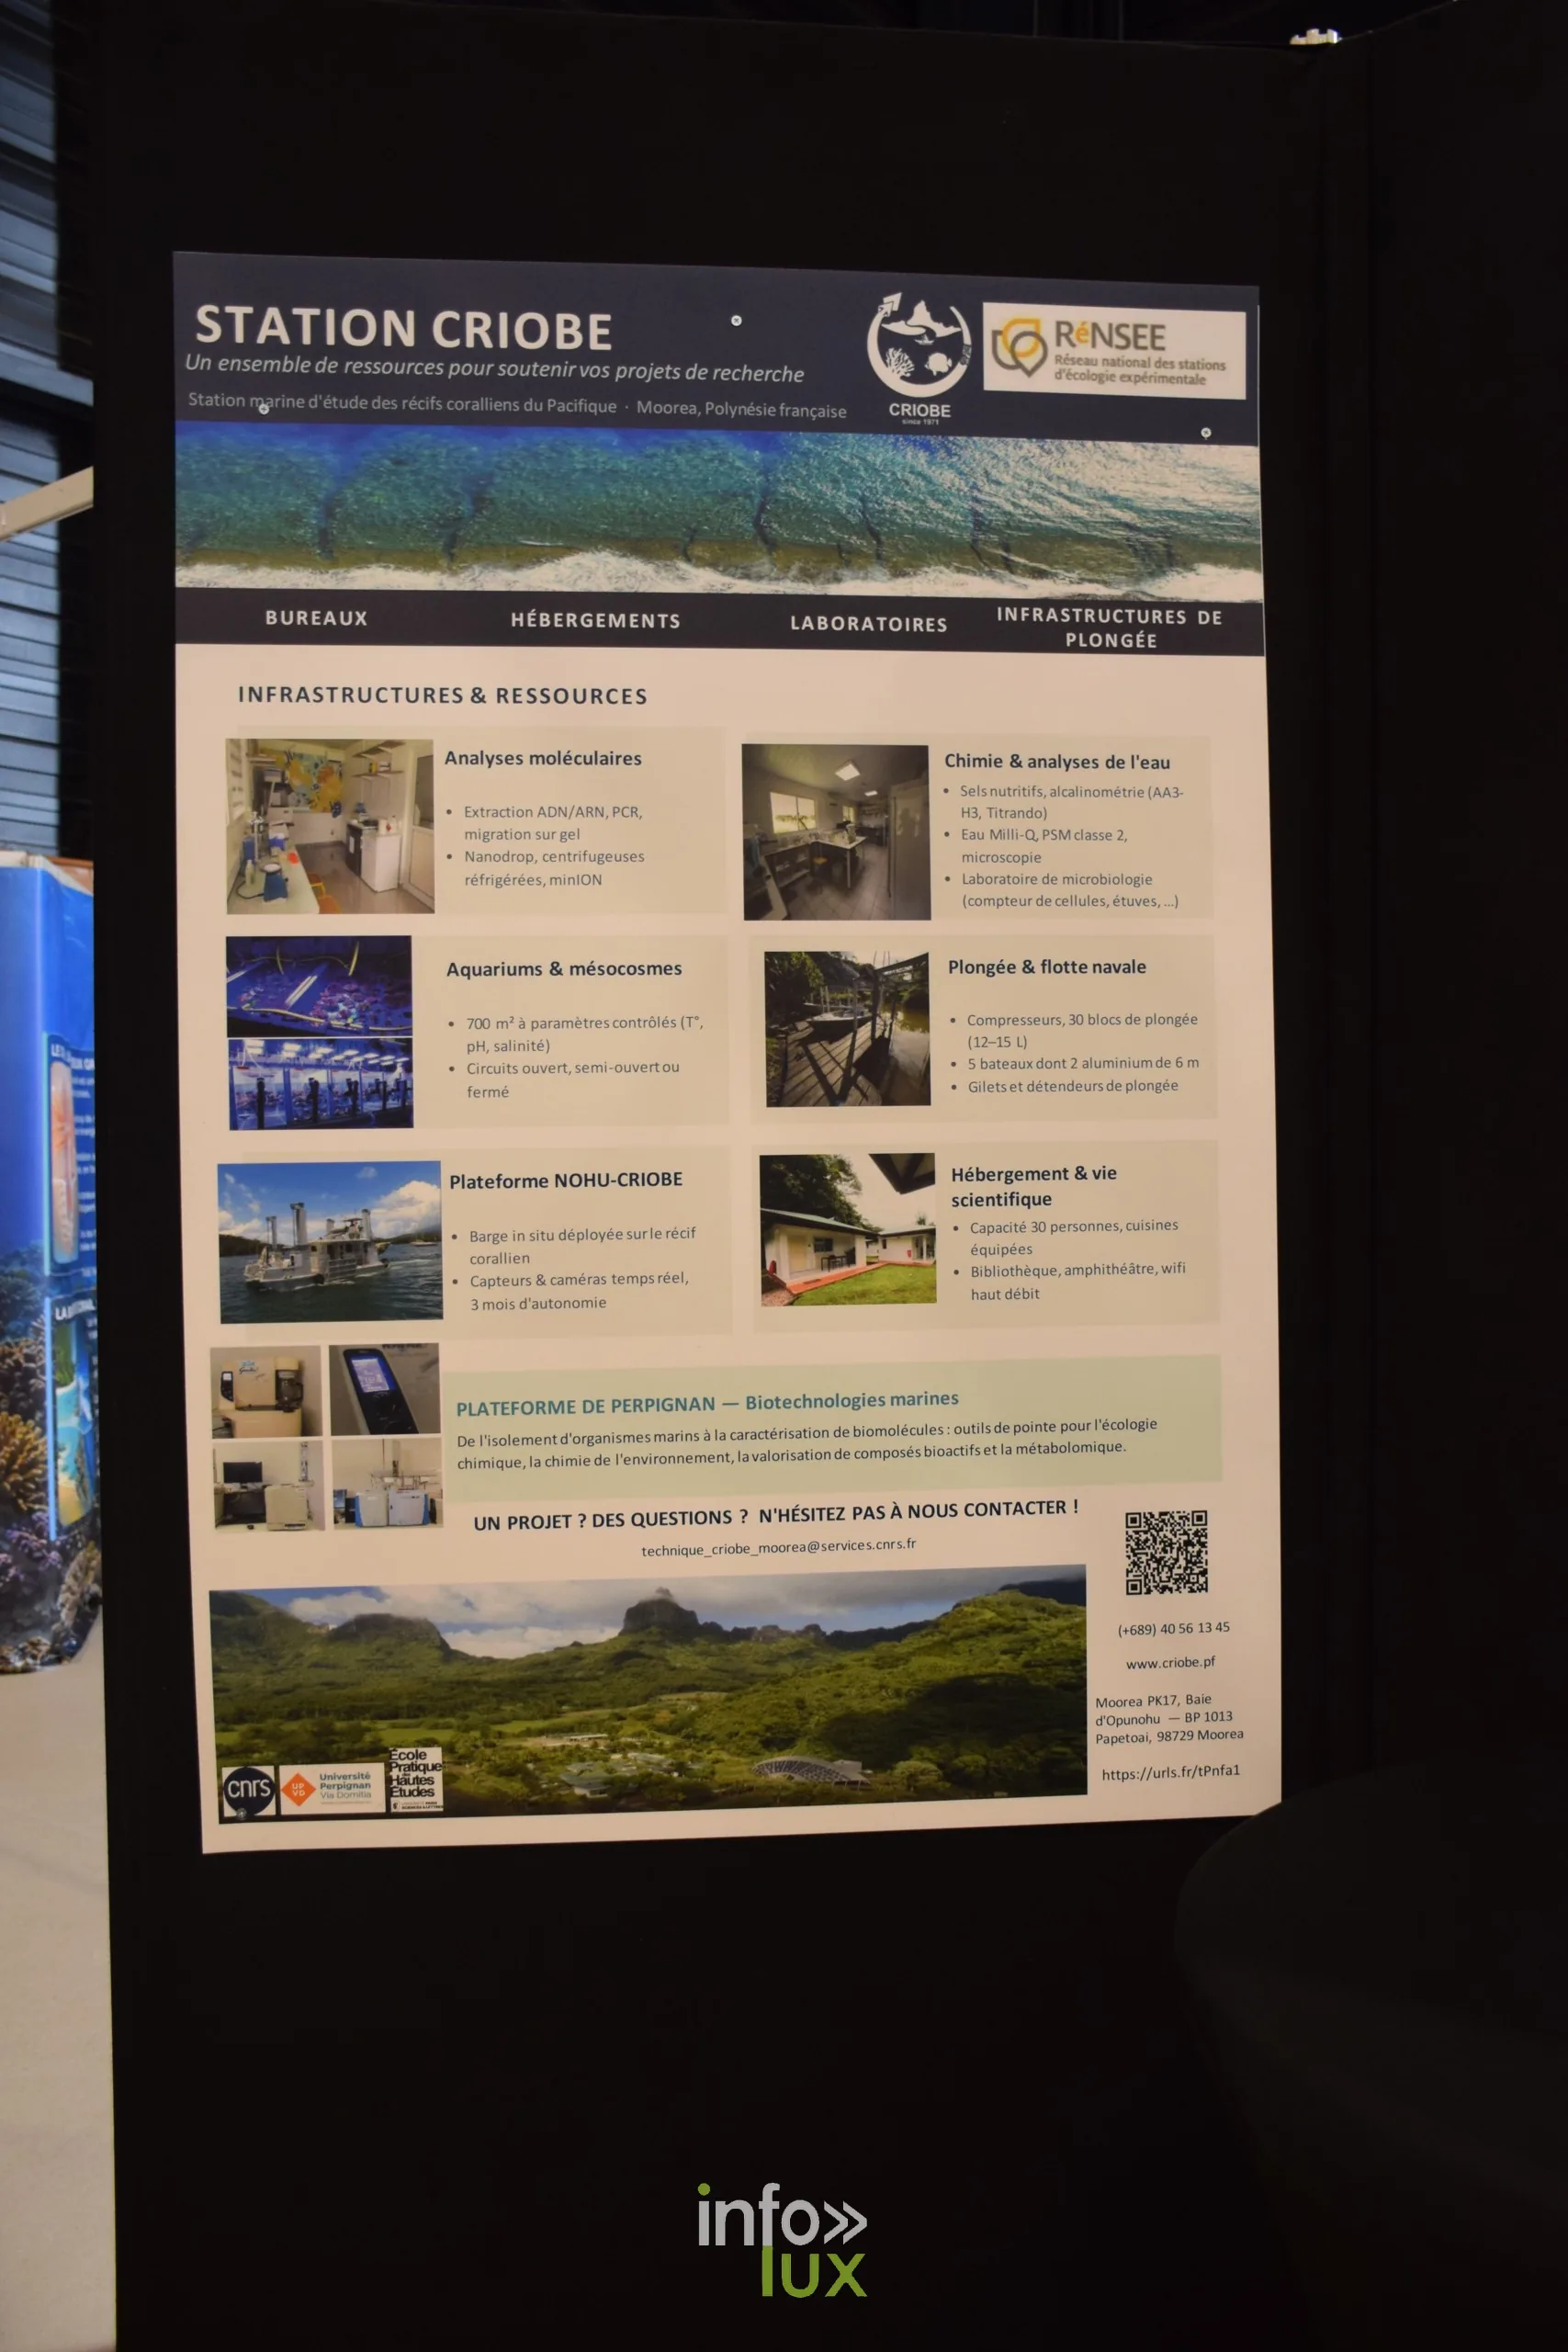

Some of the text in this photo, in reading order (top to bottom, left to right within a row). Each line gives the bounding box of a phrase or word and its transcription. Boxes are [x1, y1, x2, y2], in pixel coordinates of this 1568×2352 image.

[196, 303, 613, 350] STATION CRIOBE
[1055, 321, 1167, 351] RéNSEE
[185, 353, 805, 383] Un ensemble de ressources pour soutenir vos projets de recherche
[1054, 352, 1227, 371] Réseau national des stations
[1054, 368, 1207, 386] d'écologie expérimentale
[188, 391, 848, 421] Station marine d'étude des récifs coralliens du Pacifique Moorea, Polynésie française
[888, 401, 952, 418] CRIOBE
[265, 609, 367, 626] BUREAUX
[511, 607, 681, 628] HÉBERGEMENTS
[791, 615, 948, 632] LABORATOIRES
[997, 605, 1223, 625] INFRASTRUCTURES DE
[1066, 629, 1157, 648] PLONGÉE
[239, 685, 648, 705] INFRASTRUCTURES & RESSOURCES
[444, 750, 642, 768] Analyses moléculaires
[944, 752, 1170, 773] Chimie & analyses de l'eau
[960, 784, 1184, 800] Sels nutritifs, alcalinométrie (AA3-
[464, 804, 643, 820] Extraction ADN/ARN, PCR,
[961, 805, 1048, 820] H3, Titrando)
[464, 827, 581, 842] migration sur gel
[962, 871, 1153, 888] Laboratoire de microbiologie
[446, 959, 682, 980] Aquariums & mésocosmes
[948, 958, 1147, 978] Plongée & flotte navale
[967, 1012, 1199, 1028] Compresseurs, 30 blocs de plongée
[467, 1038, 550, 1055] pH, salinité)
[450, 1171, 683, 1189] Plateforme NOHU-CRIOBE
[952, 1165, 1118, 1185] Hébergement & vie
[952, 1191, 1053, 1209] scientifique
[970, 1218, 1179, 1236] Capacité 30 personnes, cuisines
[970, 1242, 1033, 1259] équipées
[457, 1389, 960, 1417] PLATEFORME DE PERPIGNAN Biotechnologies marines
[457, 1440, 1127, 1471] chimique, la chimie de l'environnement, la valorisation de composés bioactifs et la métabolomique.
[474, 1498, 1078, 1531] UN PROJET ? DES QUESTIONS ? N'HÉSITEZ PAS À NOUS CONTACTER !
[641, 1537, 917, 1558] technique_criobe_moorea@services.cnrs.fr
[1118, 1621, 1231, 1638] (+689) 40 56 13 45
[1125, 1655, 1216, 1669] www.criobe.pf
[1095, 1692, 1213, 1708] Moorea PK17, Baie
[1095, 1710, 1234, 1728] d'Opunohu BP 1013
[1096, 1728, 1245, 1747] Papetoai, 98729 Moorea
[389, 1748, 427, 1761] École
[320, 1771, 371, 1781] Université
[389, 1761, 443, 1774] Pratique
[1102, 1763, 1241, 1783] https://urls.fr/tPnfa1
[227, 1779, 272, 1798] cnrs
[320, 1782, 371, 1792] Perpignan
[389, 1775, 434, 1786] Hautes
[336, 1791, 372, 1799] Domitia
[389, 1786, 435, 1798] Études
